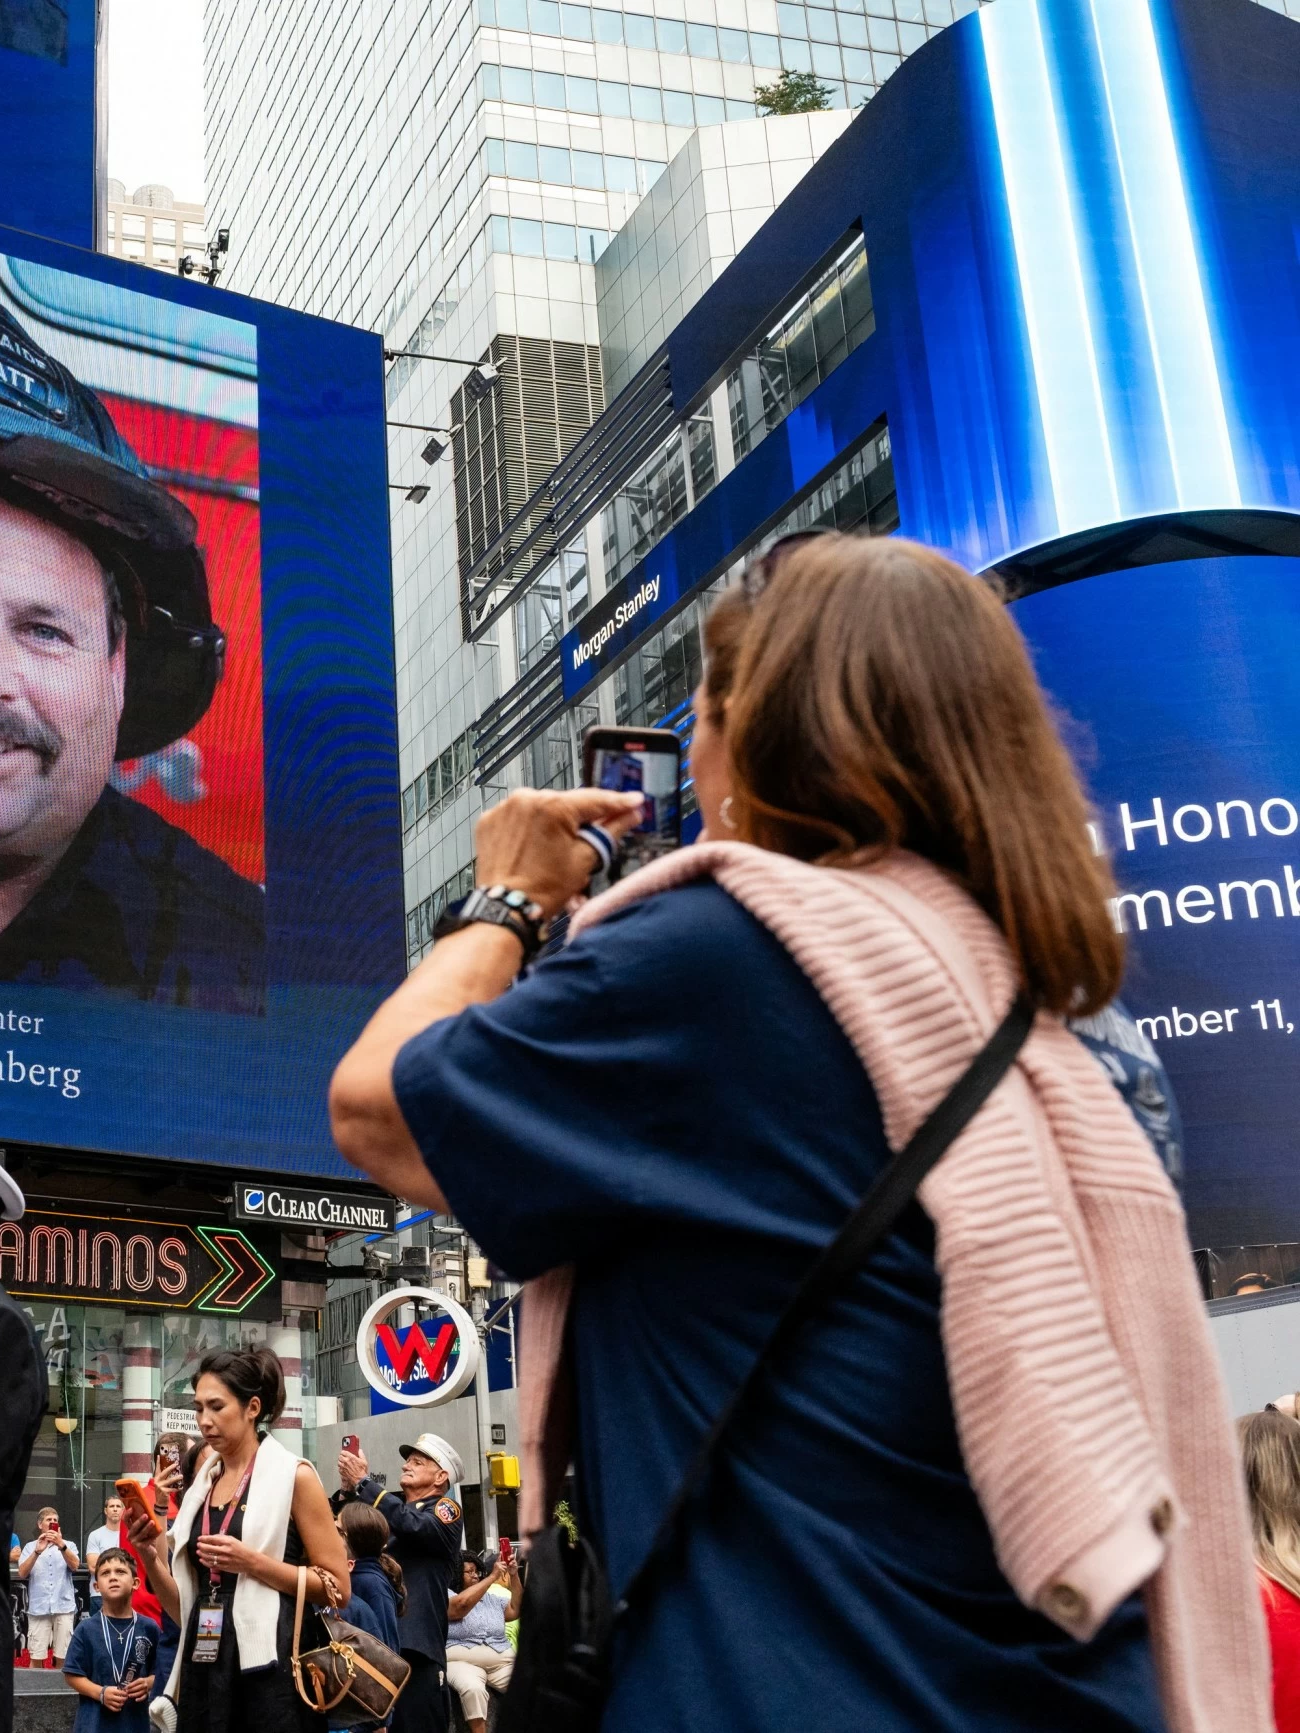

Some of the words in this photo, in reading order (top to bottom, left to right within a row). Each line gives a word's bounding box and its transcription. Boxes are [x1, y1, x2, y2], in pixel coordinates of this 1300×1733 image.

[573, 620, 615, 670] Morgan
[615, 574, 660, 629] Stanley
[1120, 797, 1299, 851] Hono
[1251, 999, 1294, 1034] 11,
[375, 1322, 459, 1385] W
[167, 1412, 197, 1421] PEDESTRIA
[167, 1422, 179, 1430] KEEP
